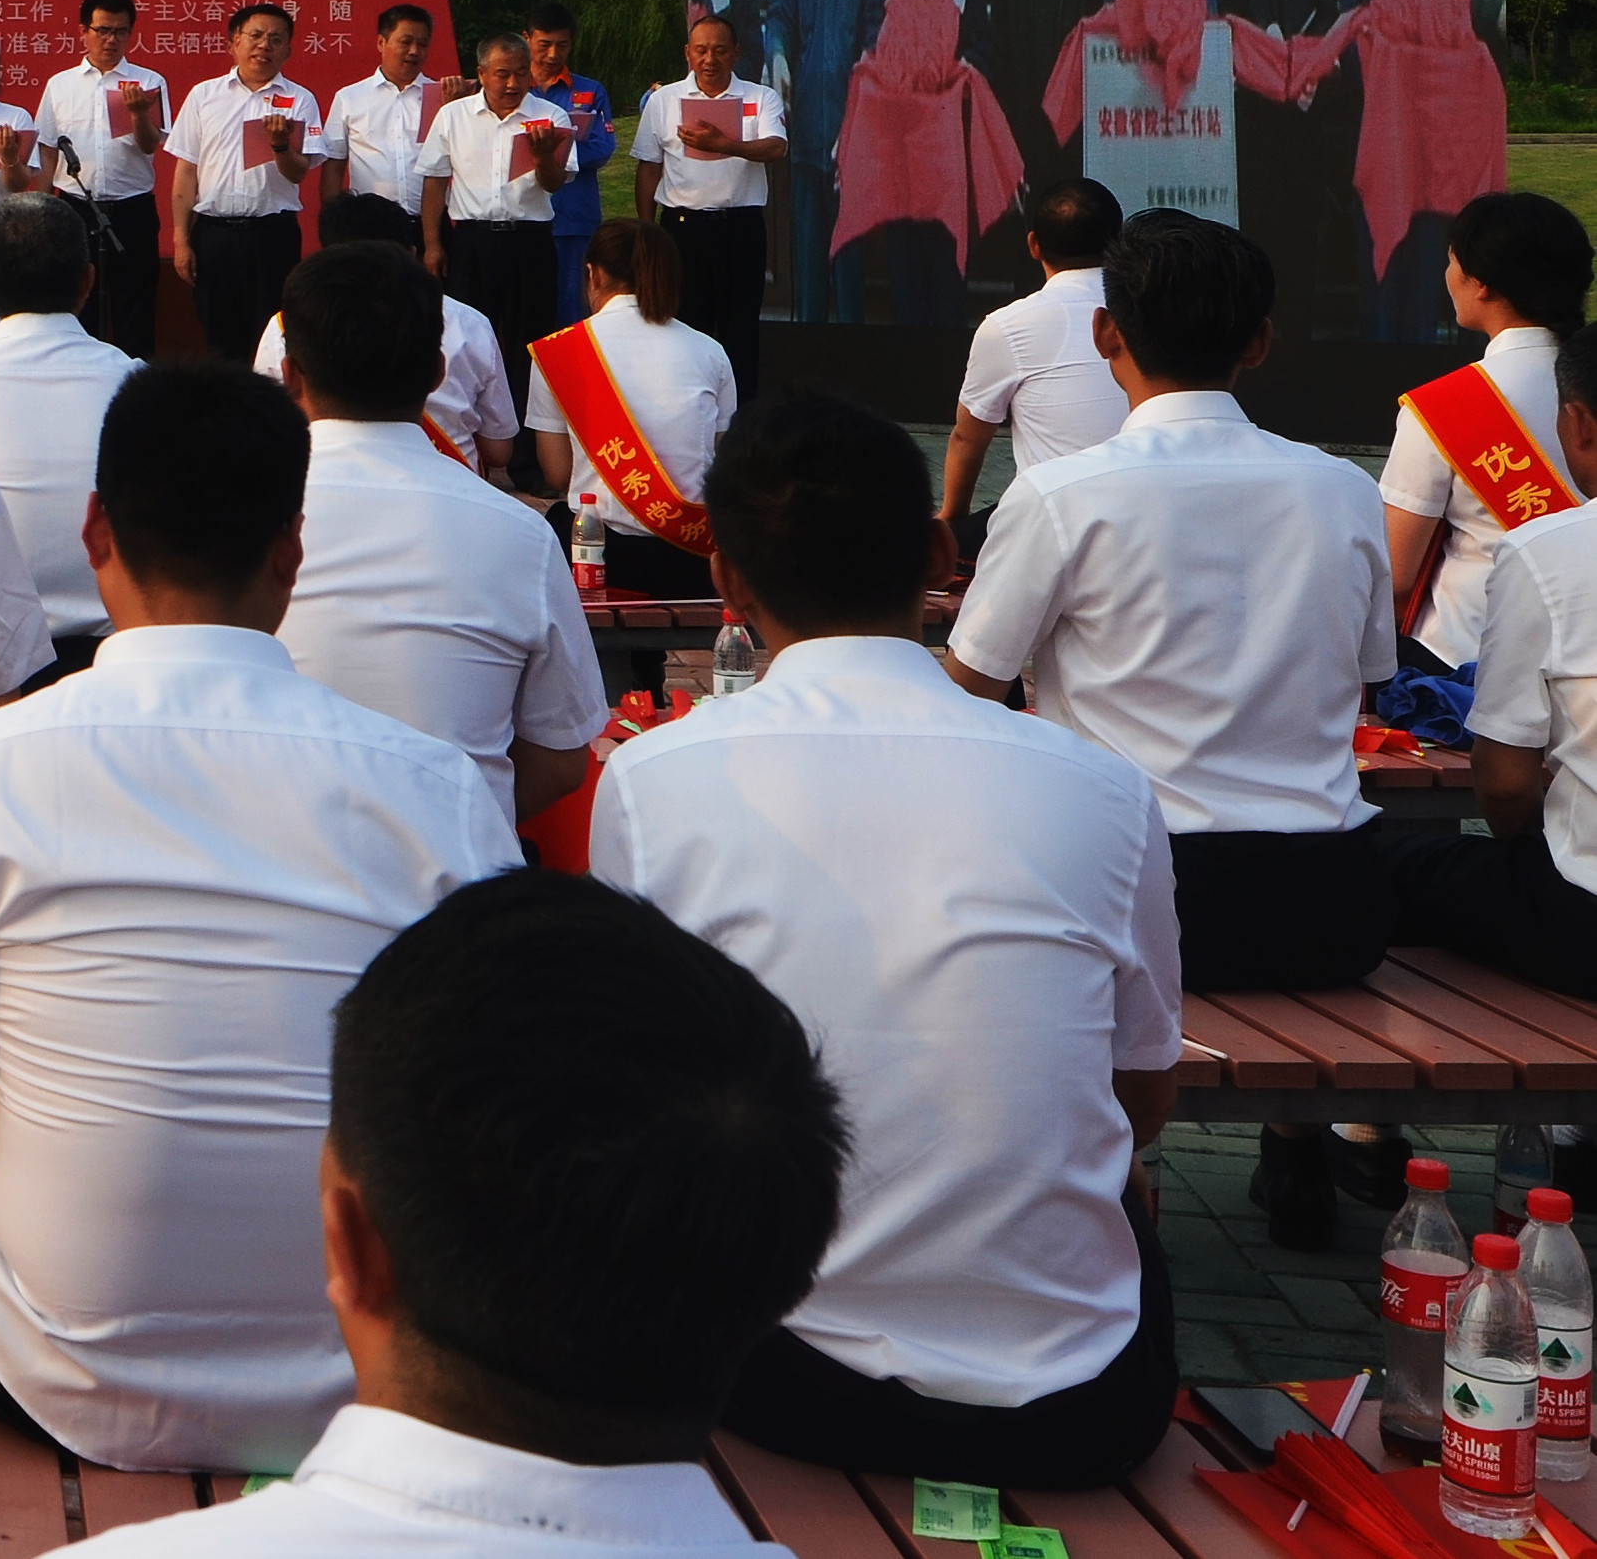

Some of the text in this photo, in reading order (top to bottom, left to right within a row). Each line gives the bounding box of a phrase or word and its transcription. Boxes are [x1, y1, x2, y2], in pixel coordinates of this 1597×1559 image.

[596, 436, 713, 545] 优秀党务
[1471, 442, 1552, 521] 优秀
[1465, 1456, 1500, 1472] SPRING
